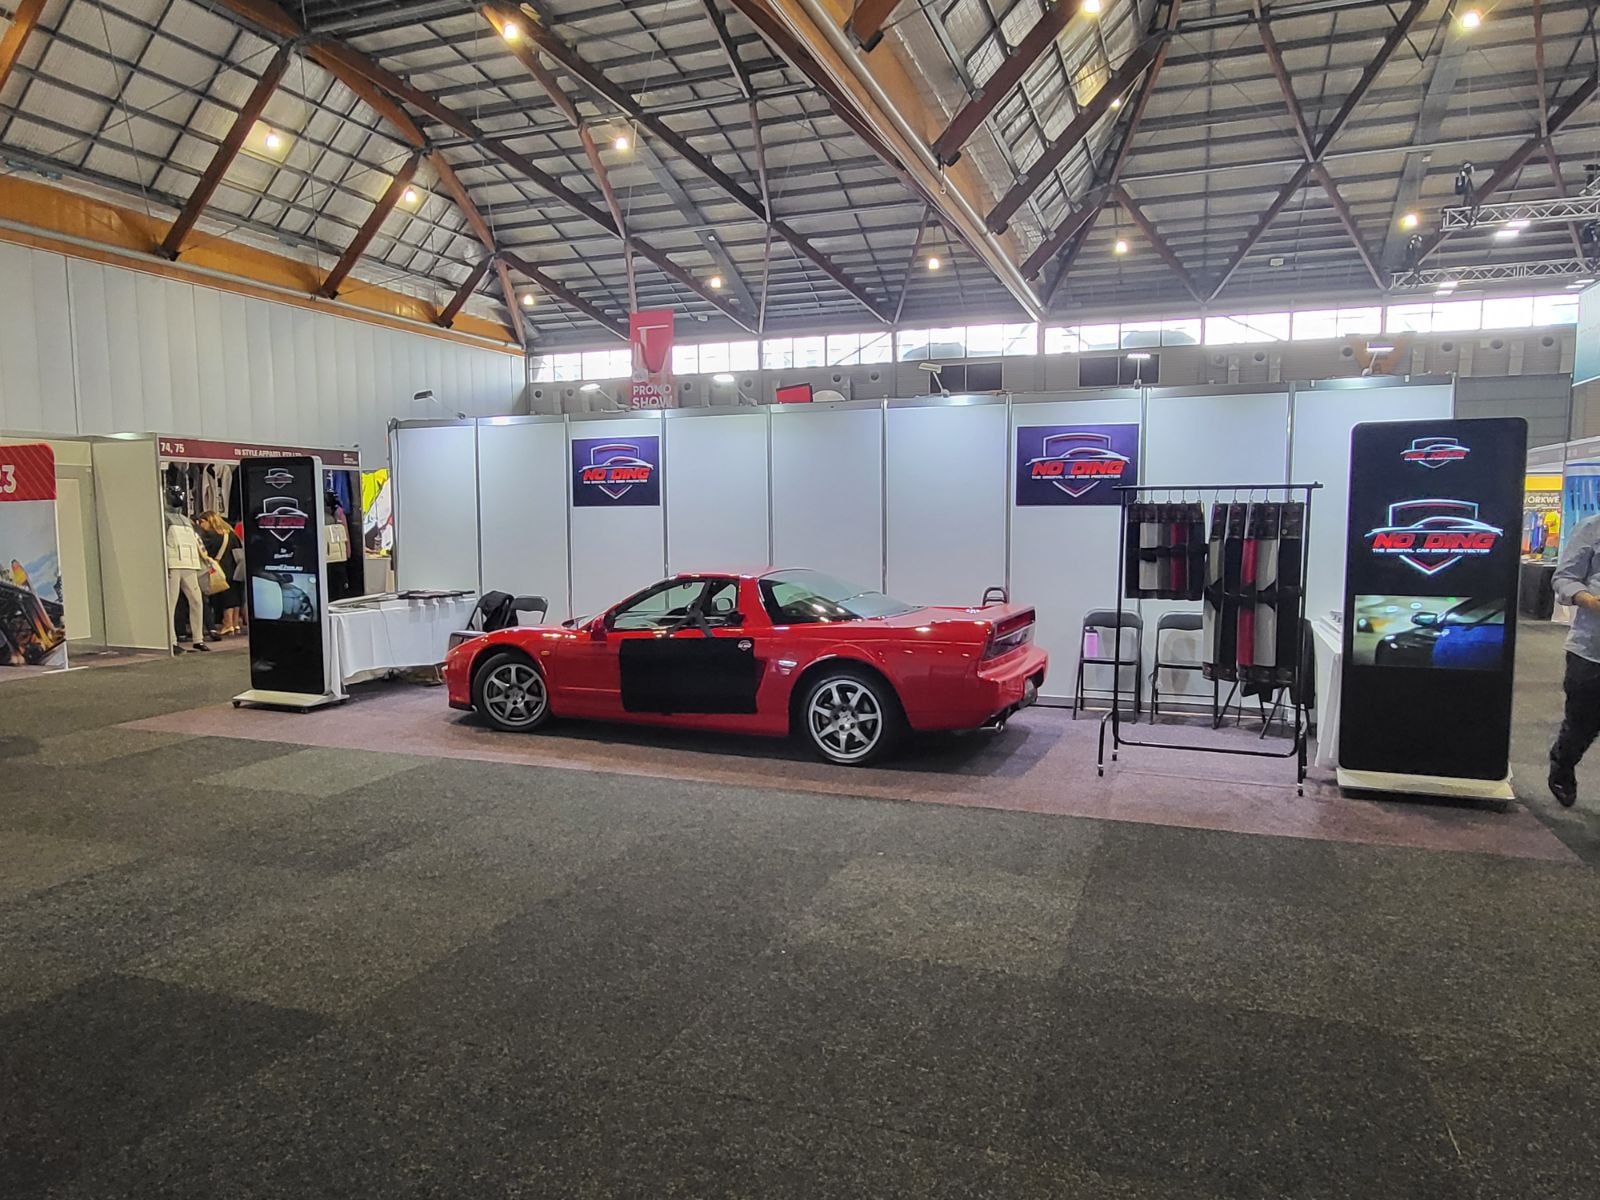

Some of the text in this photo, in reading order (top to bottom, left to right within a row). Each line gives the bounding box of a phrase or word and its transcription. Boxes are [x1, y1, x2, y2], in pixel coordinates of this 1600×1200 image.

[632, 384, 672, 396] PROMO
[632, 395, 673, 409] SHOW
[160, 442, 185, 454] 74, 75
[583, 468, 649, 481] NO DING
[1032, 461, 1125, 475] NO DING
[0, 464, 17, 494] 3
[1373, 532, 1496, 549] NO DING
